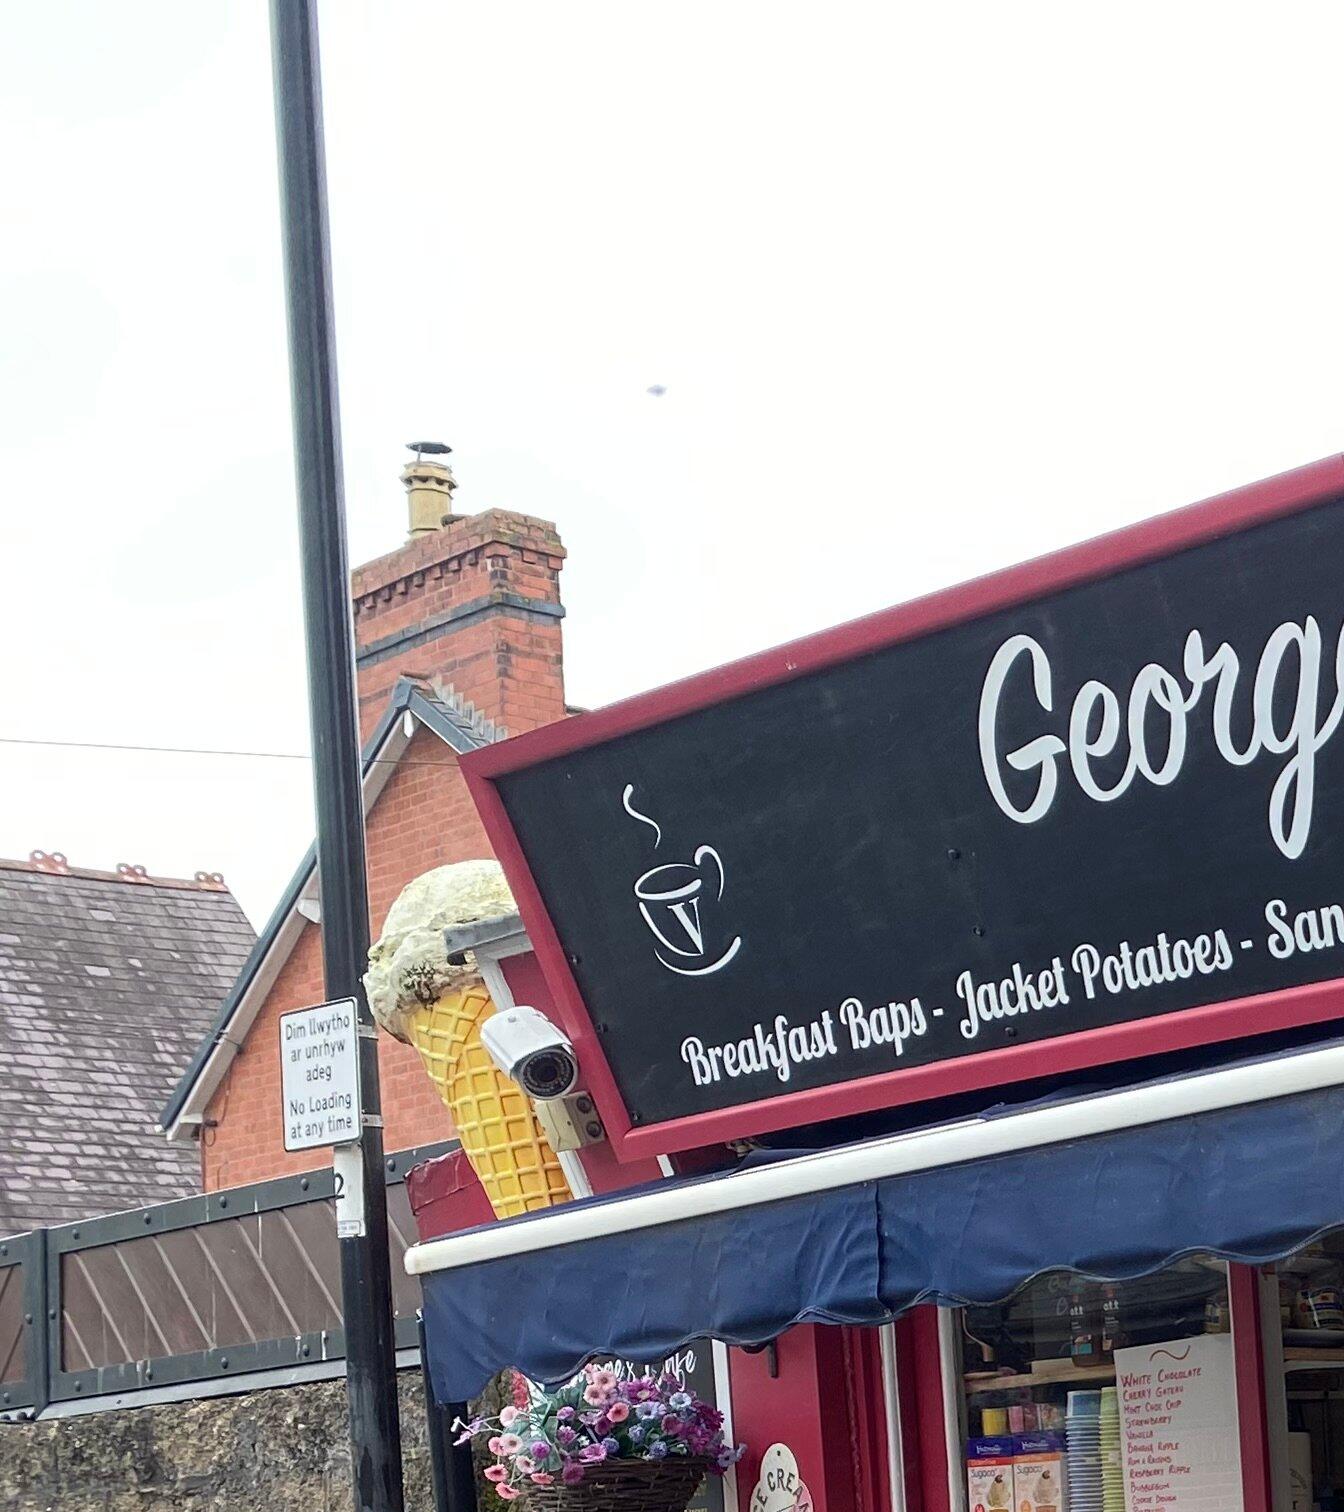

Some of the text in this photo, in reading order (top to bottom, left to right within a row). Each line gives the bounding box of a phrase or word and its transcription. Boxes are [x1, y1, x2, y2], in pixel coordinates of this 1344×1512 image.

[681, 1016, 837, 1085] Breakfast
[840, 998, 926, 1056] Baps
[957, 957, 1069, 1038] Jacket
[1072, 929, 1232, 998] Potatoes
[286, 1014, 350, 1041] Dim llwytho
[291, 1038, 345, 1062] ar unrhyw
[306, 1065, 332, 1082] adeg
[290, 1092, 352, 1116] No Loading
[291, 1115, 352, 1139] at any time
[1120, 1367, 1202, 1387] WHITE CHOCOLATE
[1122, 1388, 1151, 1402] CHERRY
[1123, 1404, 1141, 1414] MINT
[1165, 1400, 1182, 1410] CHIP
[1125, 1415, 1172, 1428] STRAWBERRY
[1126, 1431, 1153, 1440] VANILLA
